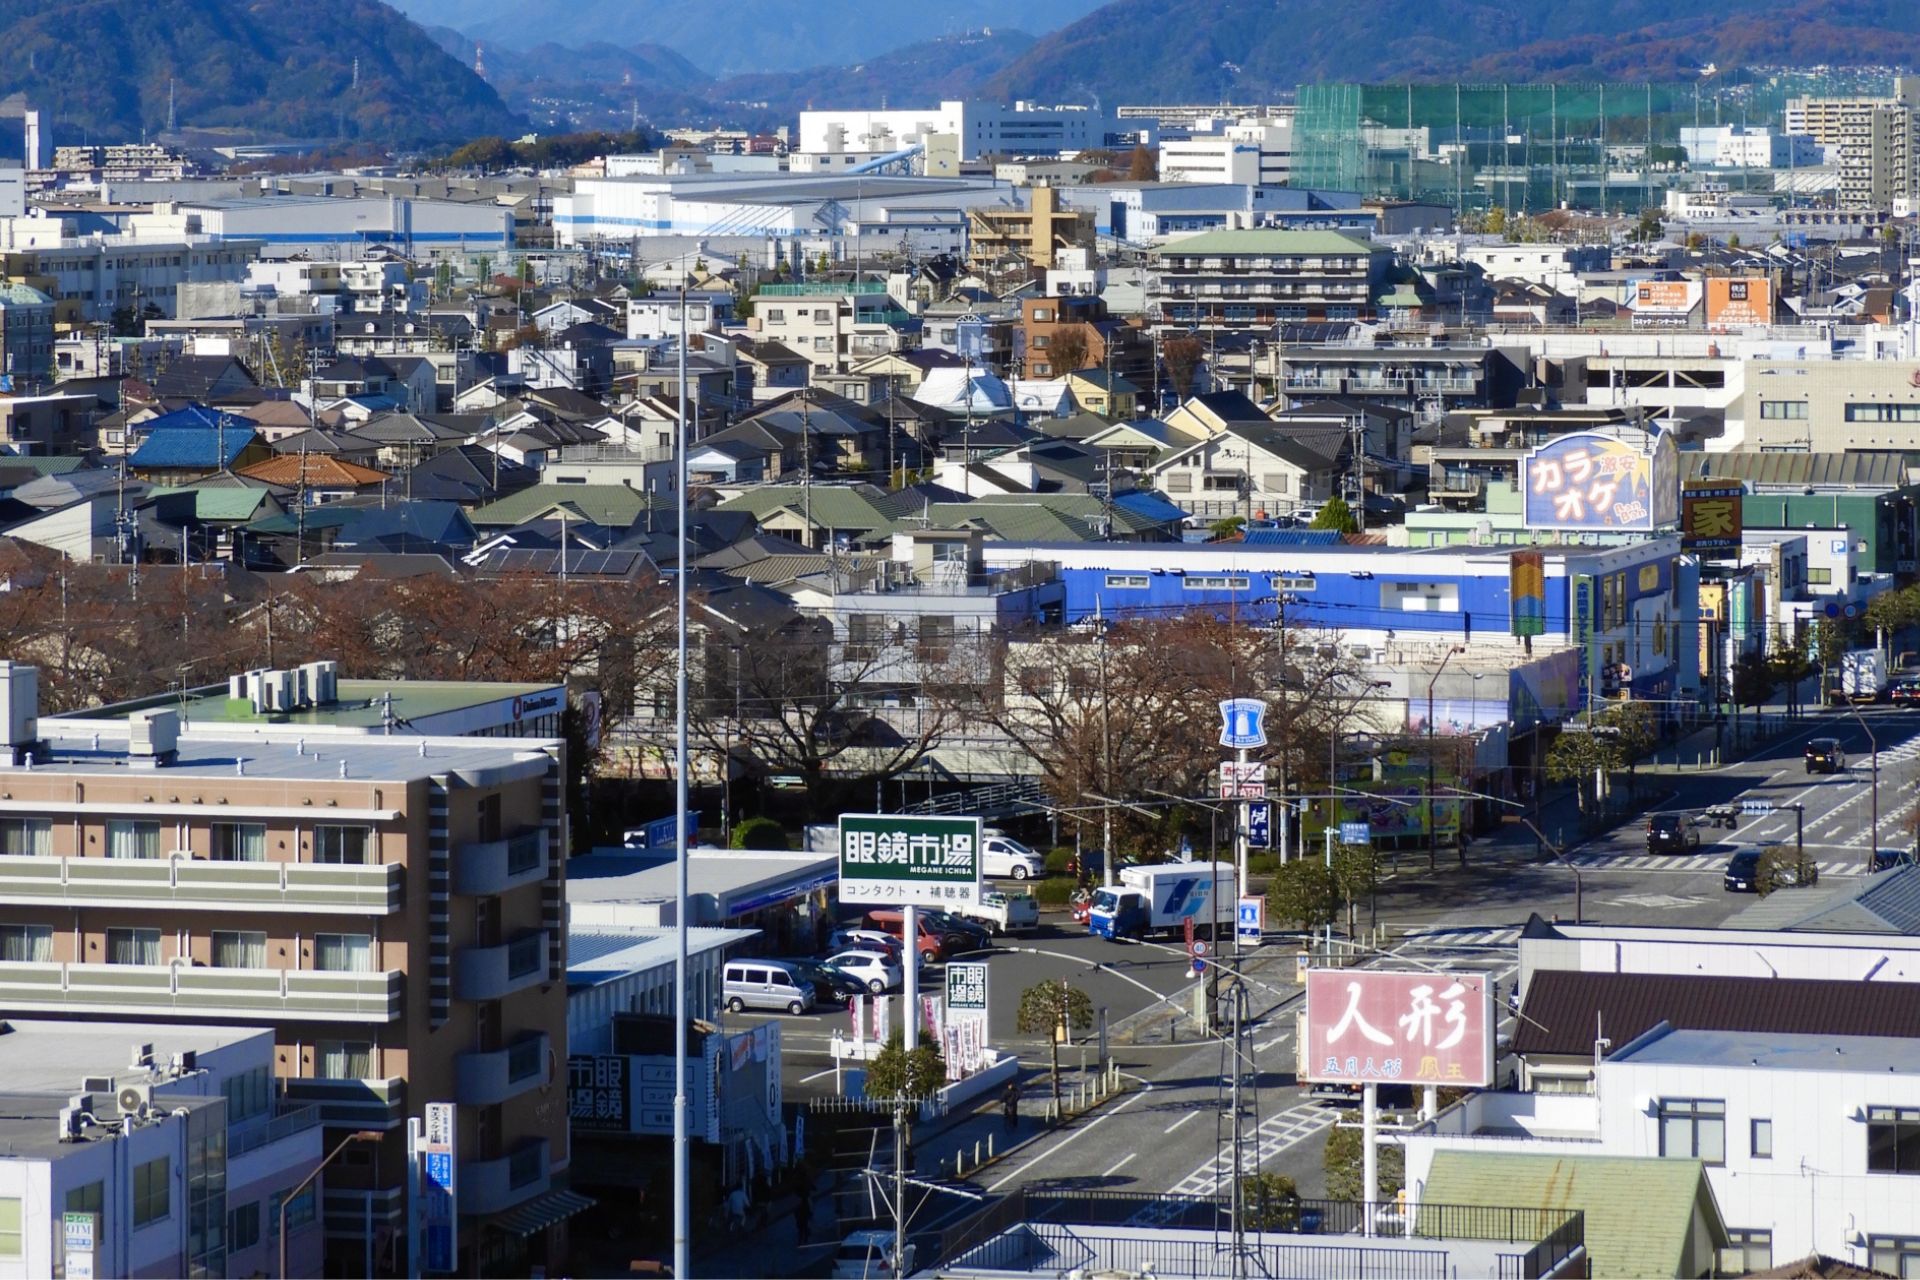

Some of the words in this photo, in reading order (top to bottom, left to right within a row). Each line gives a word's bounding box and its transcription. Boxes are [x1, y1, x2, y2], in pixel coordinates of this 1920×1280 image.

[1692, 500, 1735, 537] 家
[1833, 541, 1844, 552] P
[845, 830, 973, 867] 眼鏡市場
[909, 866, 943, 875] MEGANE
[944, 867, 972, 875] ICHIBA
[1326, 981, 1468, 1050] 人形
[1321, 1056, 1403, 1078] 五月人形
